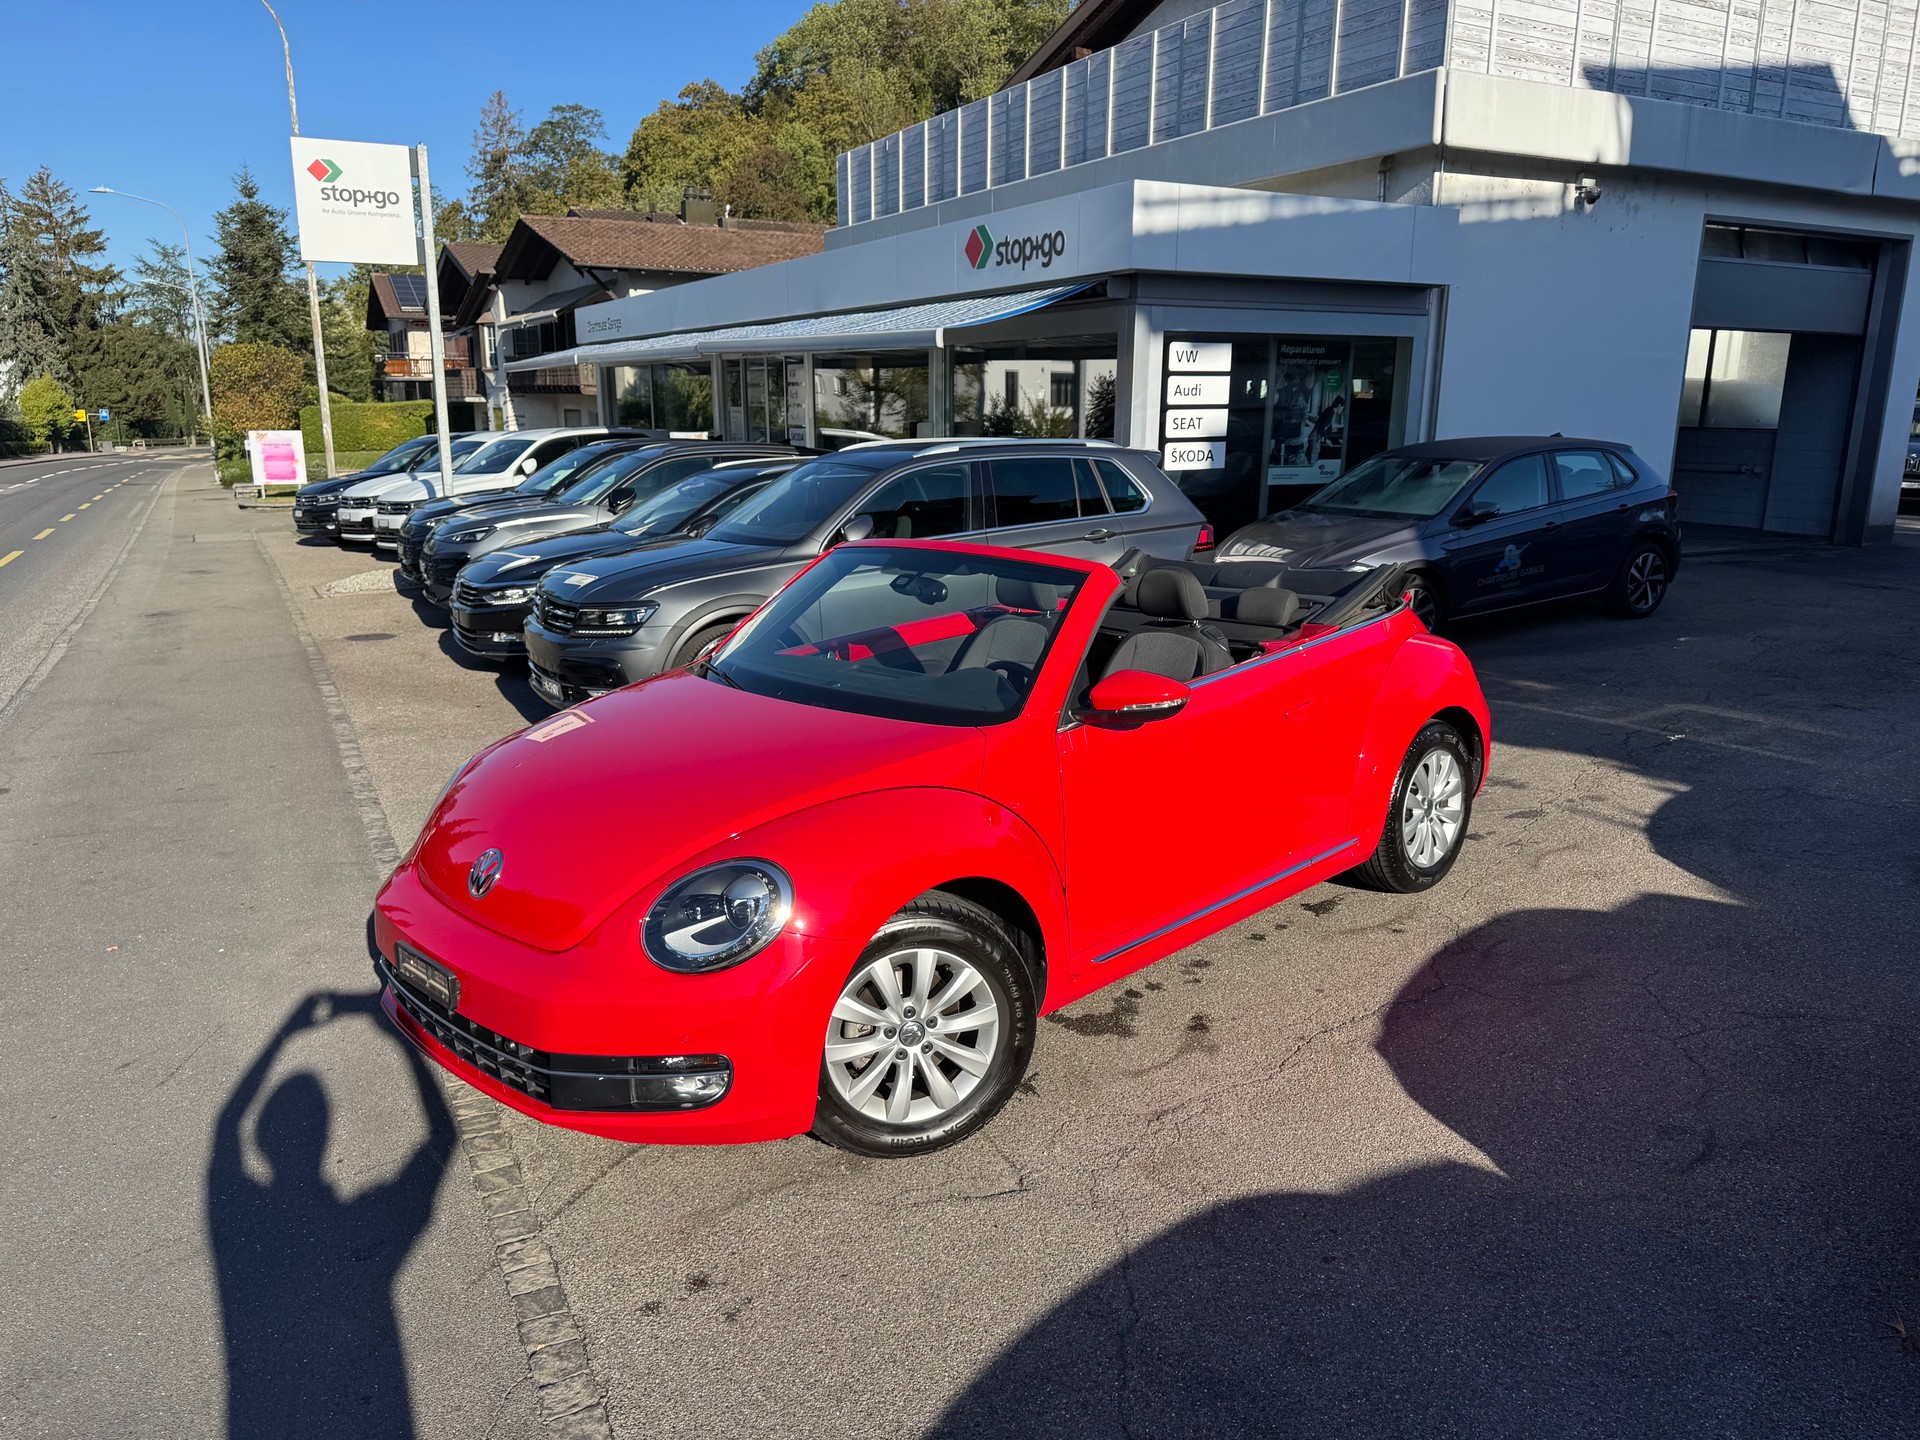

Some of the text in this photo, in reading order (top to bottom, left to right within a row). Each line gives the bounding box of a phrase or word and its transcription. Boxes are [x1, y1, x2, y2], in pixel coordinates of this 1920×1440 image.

[320, 185, 400, 209] stop+go
[996, 230, 1065, 271] stop+go
[1176, 350, 1199, 363] VW
[1281, 344, 1326, 356] Reparaturen
[1173, 383, 1202, 397] Audi
[1172, 417, 1204, 430] SEAT
[1171, 448, 1214, 463] ŠKODA
